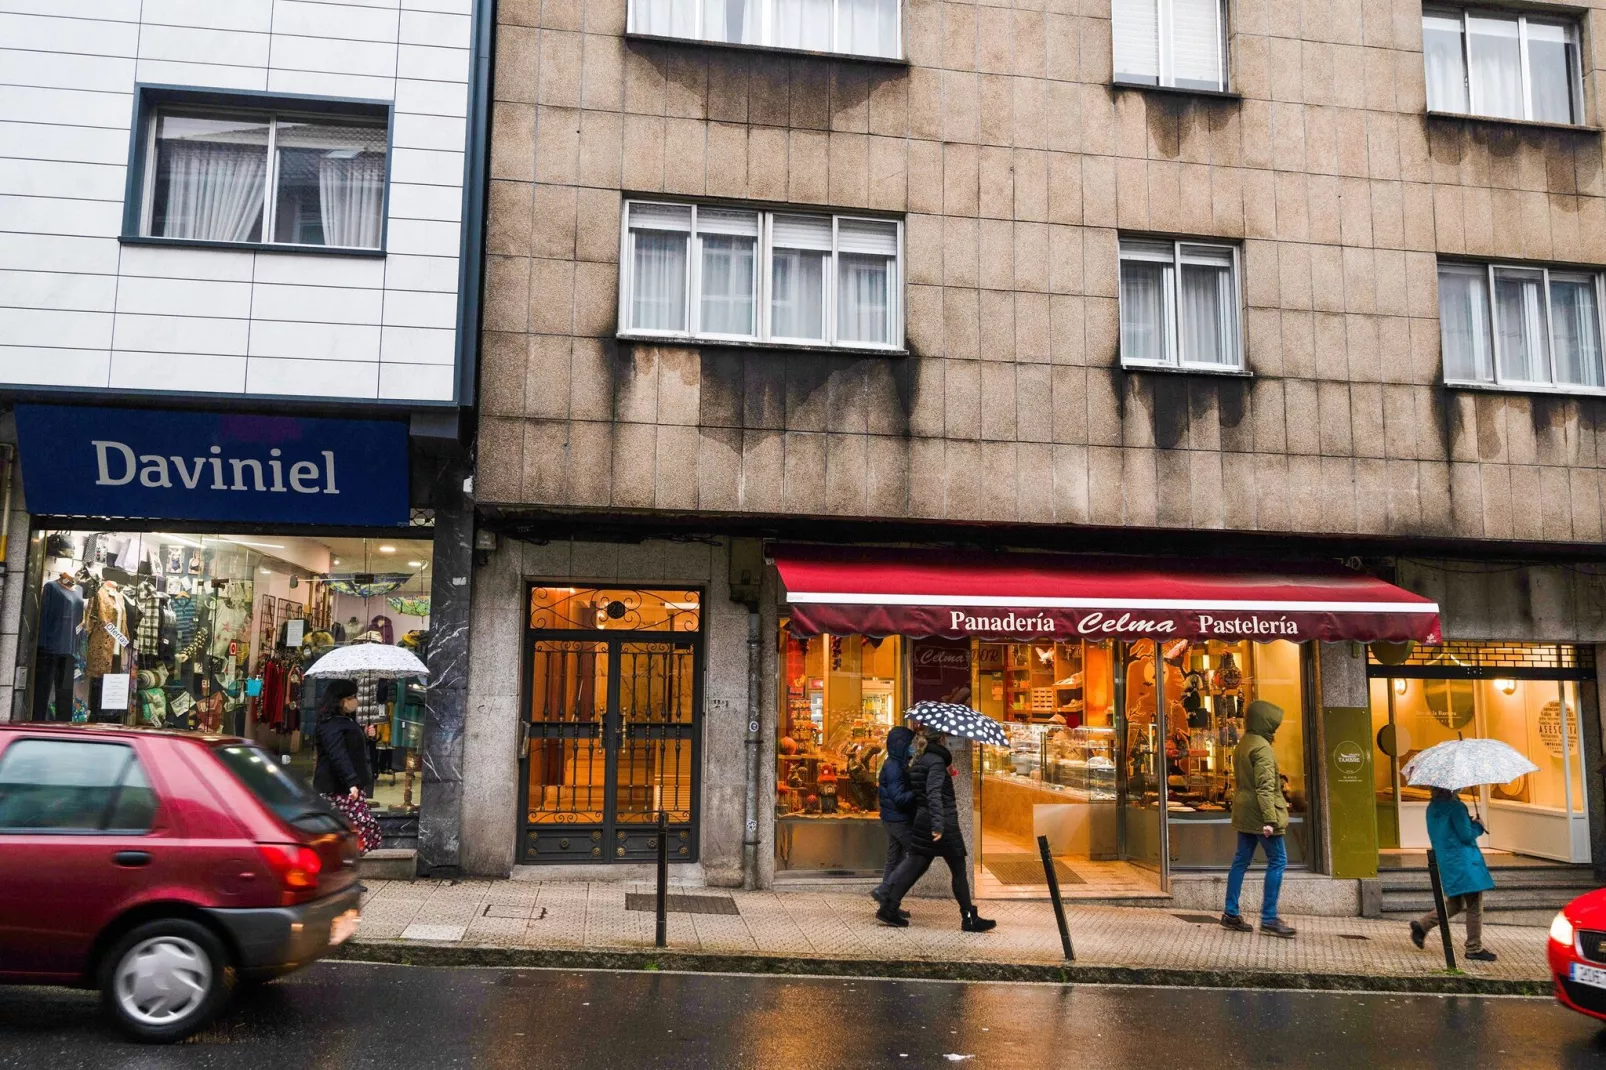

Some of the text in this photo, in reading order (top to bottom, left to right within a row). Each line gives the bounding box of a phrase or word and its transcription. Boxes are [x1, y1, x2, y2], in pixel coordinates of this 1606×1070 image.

[91, 440, 340, 494] Daviniel
[106, 623, 128, 647] Ofertas
[950, 611, 1299, 635] Panadería Celma Pastelería
[920, 649, 965, 664] Celma
